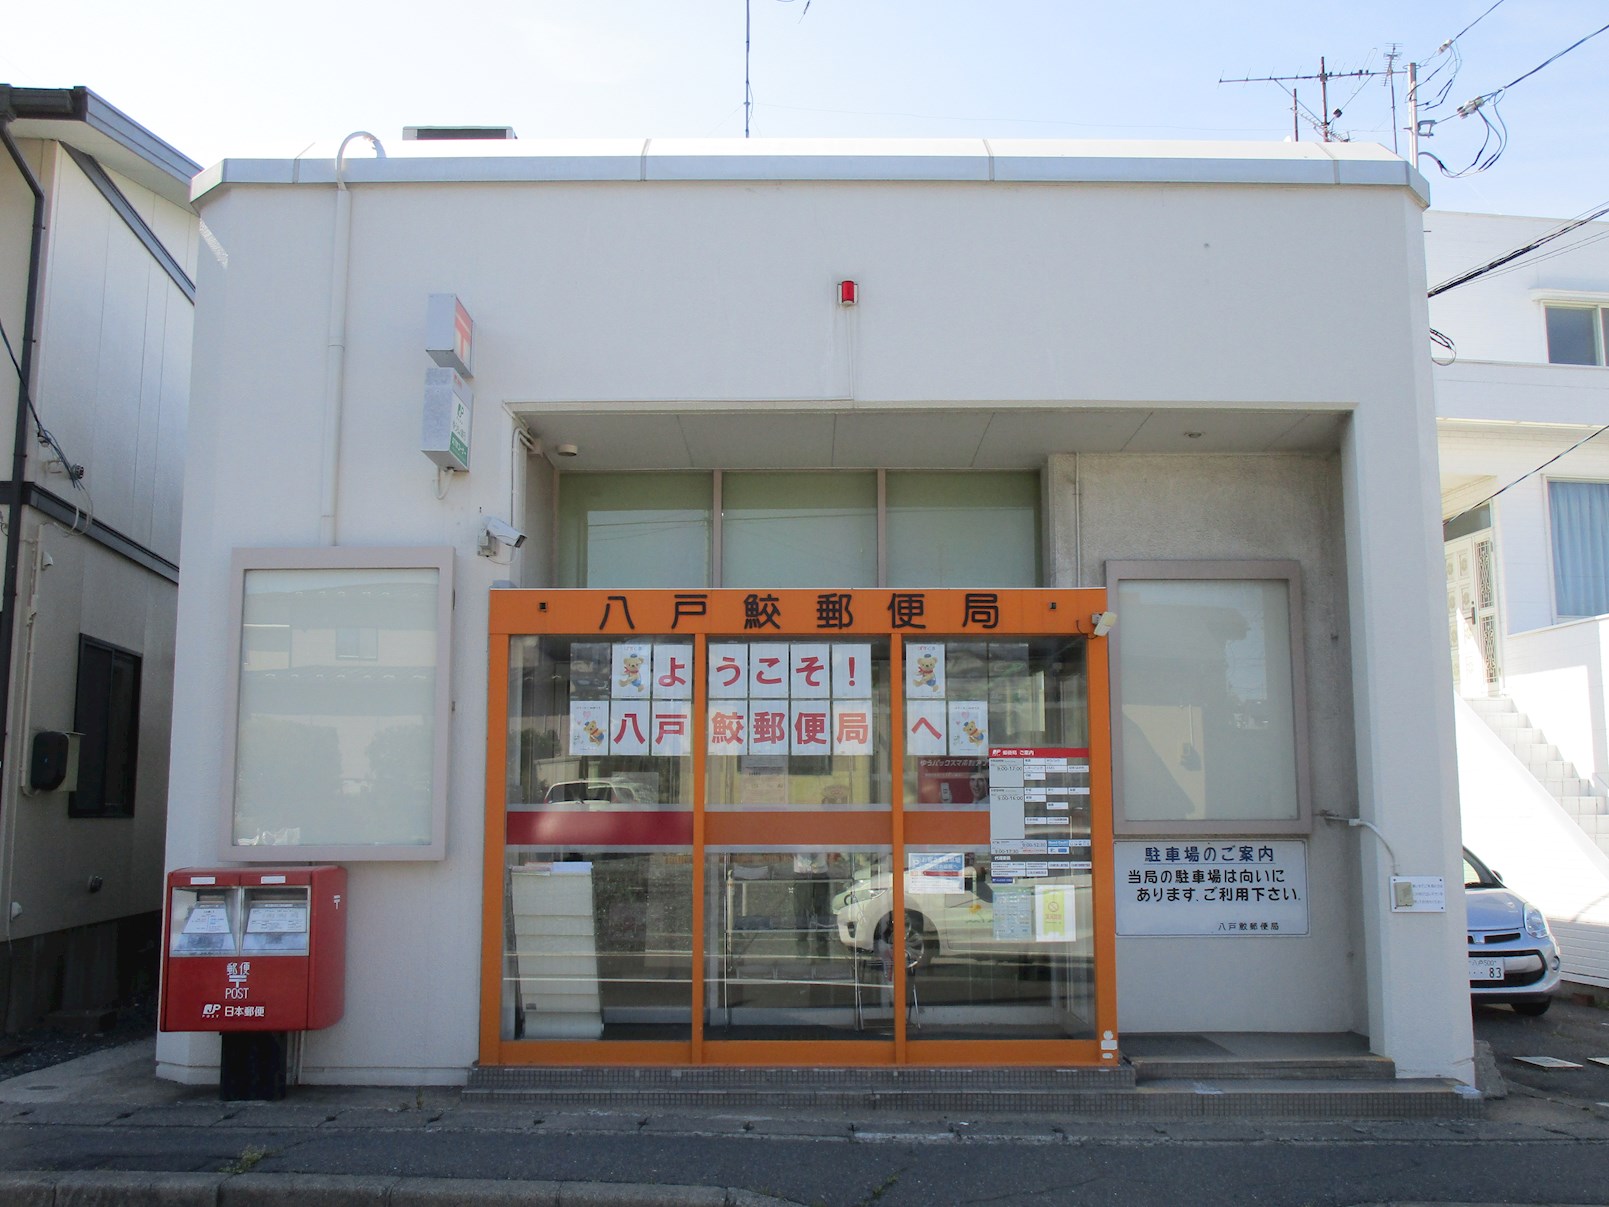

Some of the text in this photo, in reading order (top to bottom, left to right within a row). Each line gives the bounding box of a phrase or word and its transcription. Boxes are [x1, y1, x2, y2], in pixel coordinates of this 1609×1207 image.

[599, 592, 999, 630] 八戸鮫郵便局
[1144, 845, 1274, 863] 駐車場のご案内
[1128, 869, 1285, 884] 当局の駐車場は向いに
[226, 962, 250, 976] 郵便
[225, 987, 249, 1000] POST
[224, 1006, 265, 1017] 日本郵便
